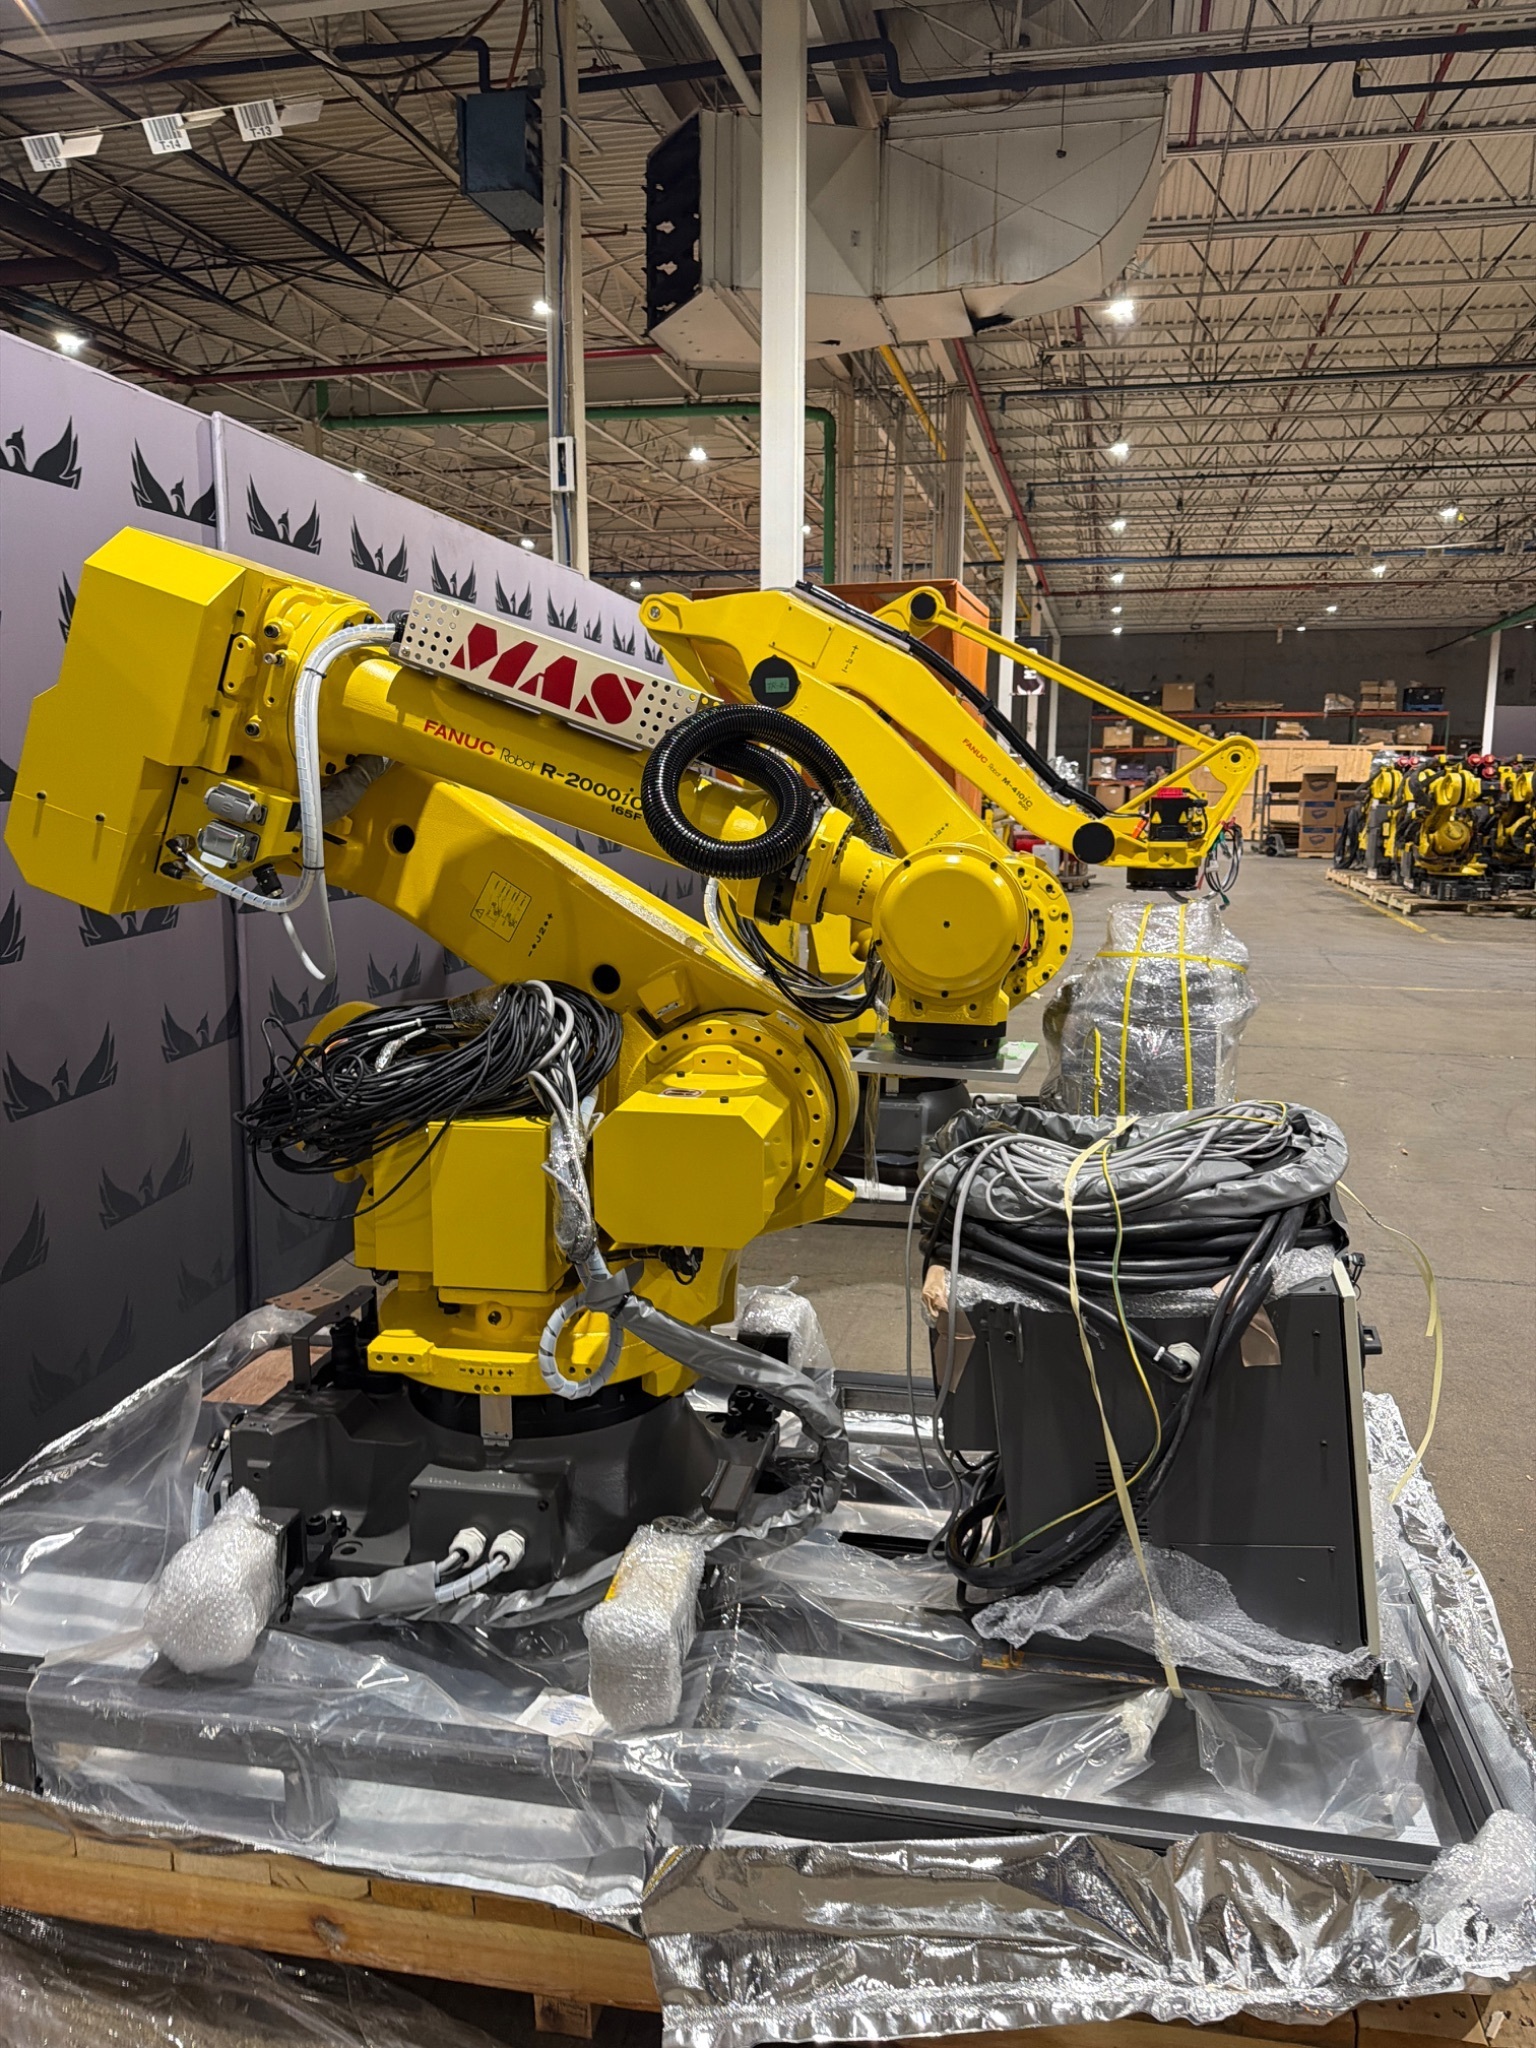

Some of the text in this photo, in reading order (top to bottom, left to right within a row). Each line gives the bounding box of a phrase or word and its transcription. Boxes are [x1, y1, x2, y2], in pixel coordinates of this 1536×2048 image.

[248, 126, 273, 137] T-13
[158, 139, 182, 151] T-14
[40, 158, 62, 169] T-15
[450, 622, 645, 724] MAS
[423, 719, 496, 756] FANUC
[500, 747, 535, 772] Robot
[962, 738, 988, 764] FANUC
[610, 804, 642, 821] 165F
